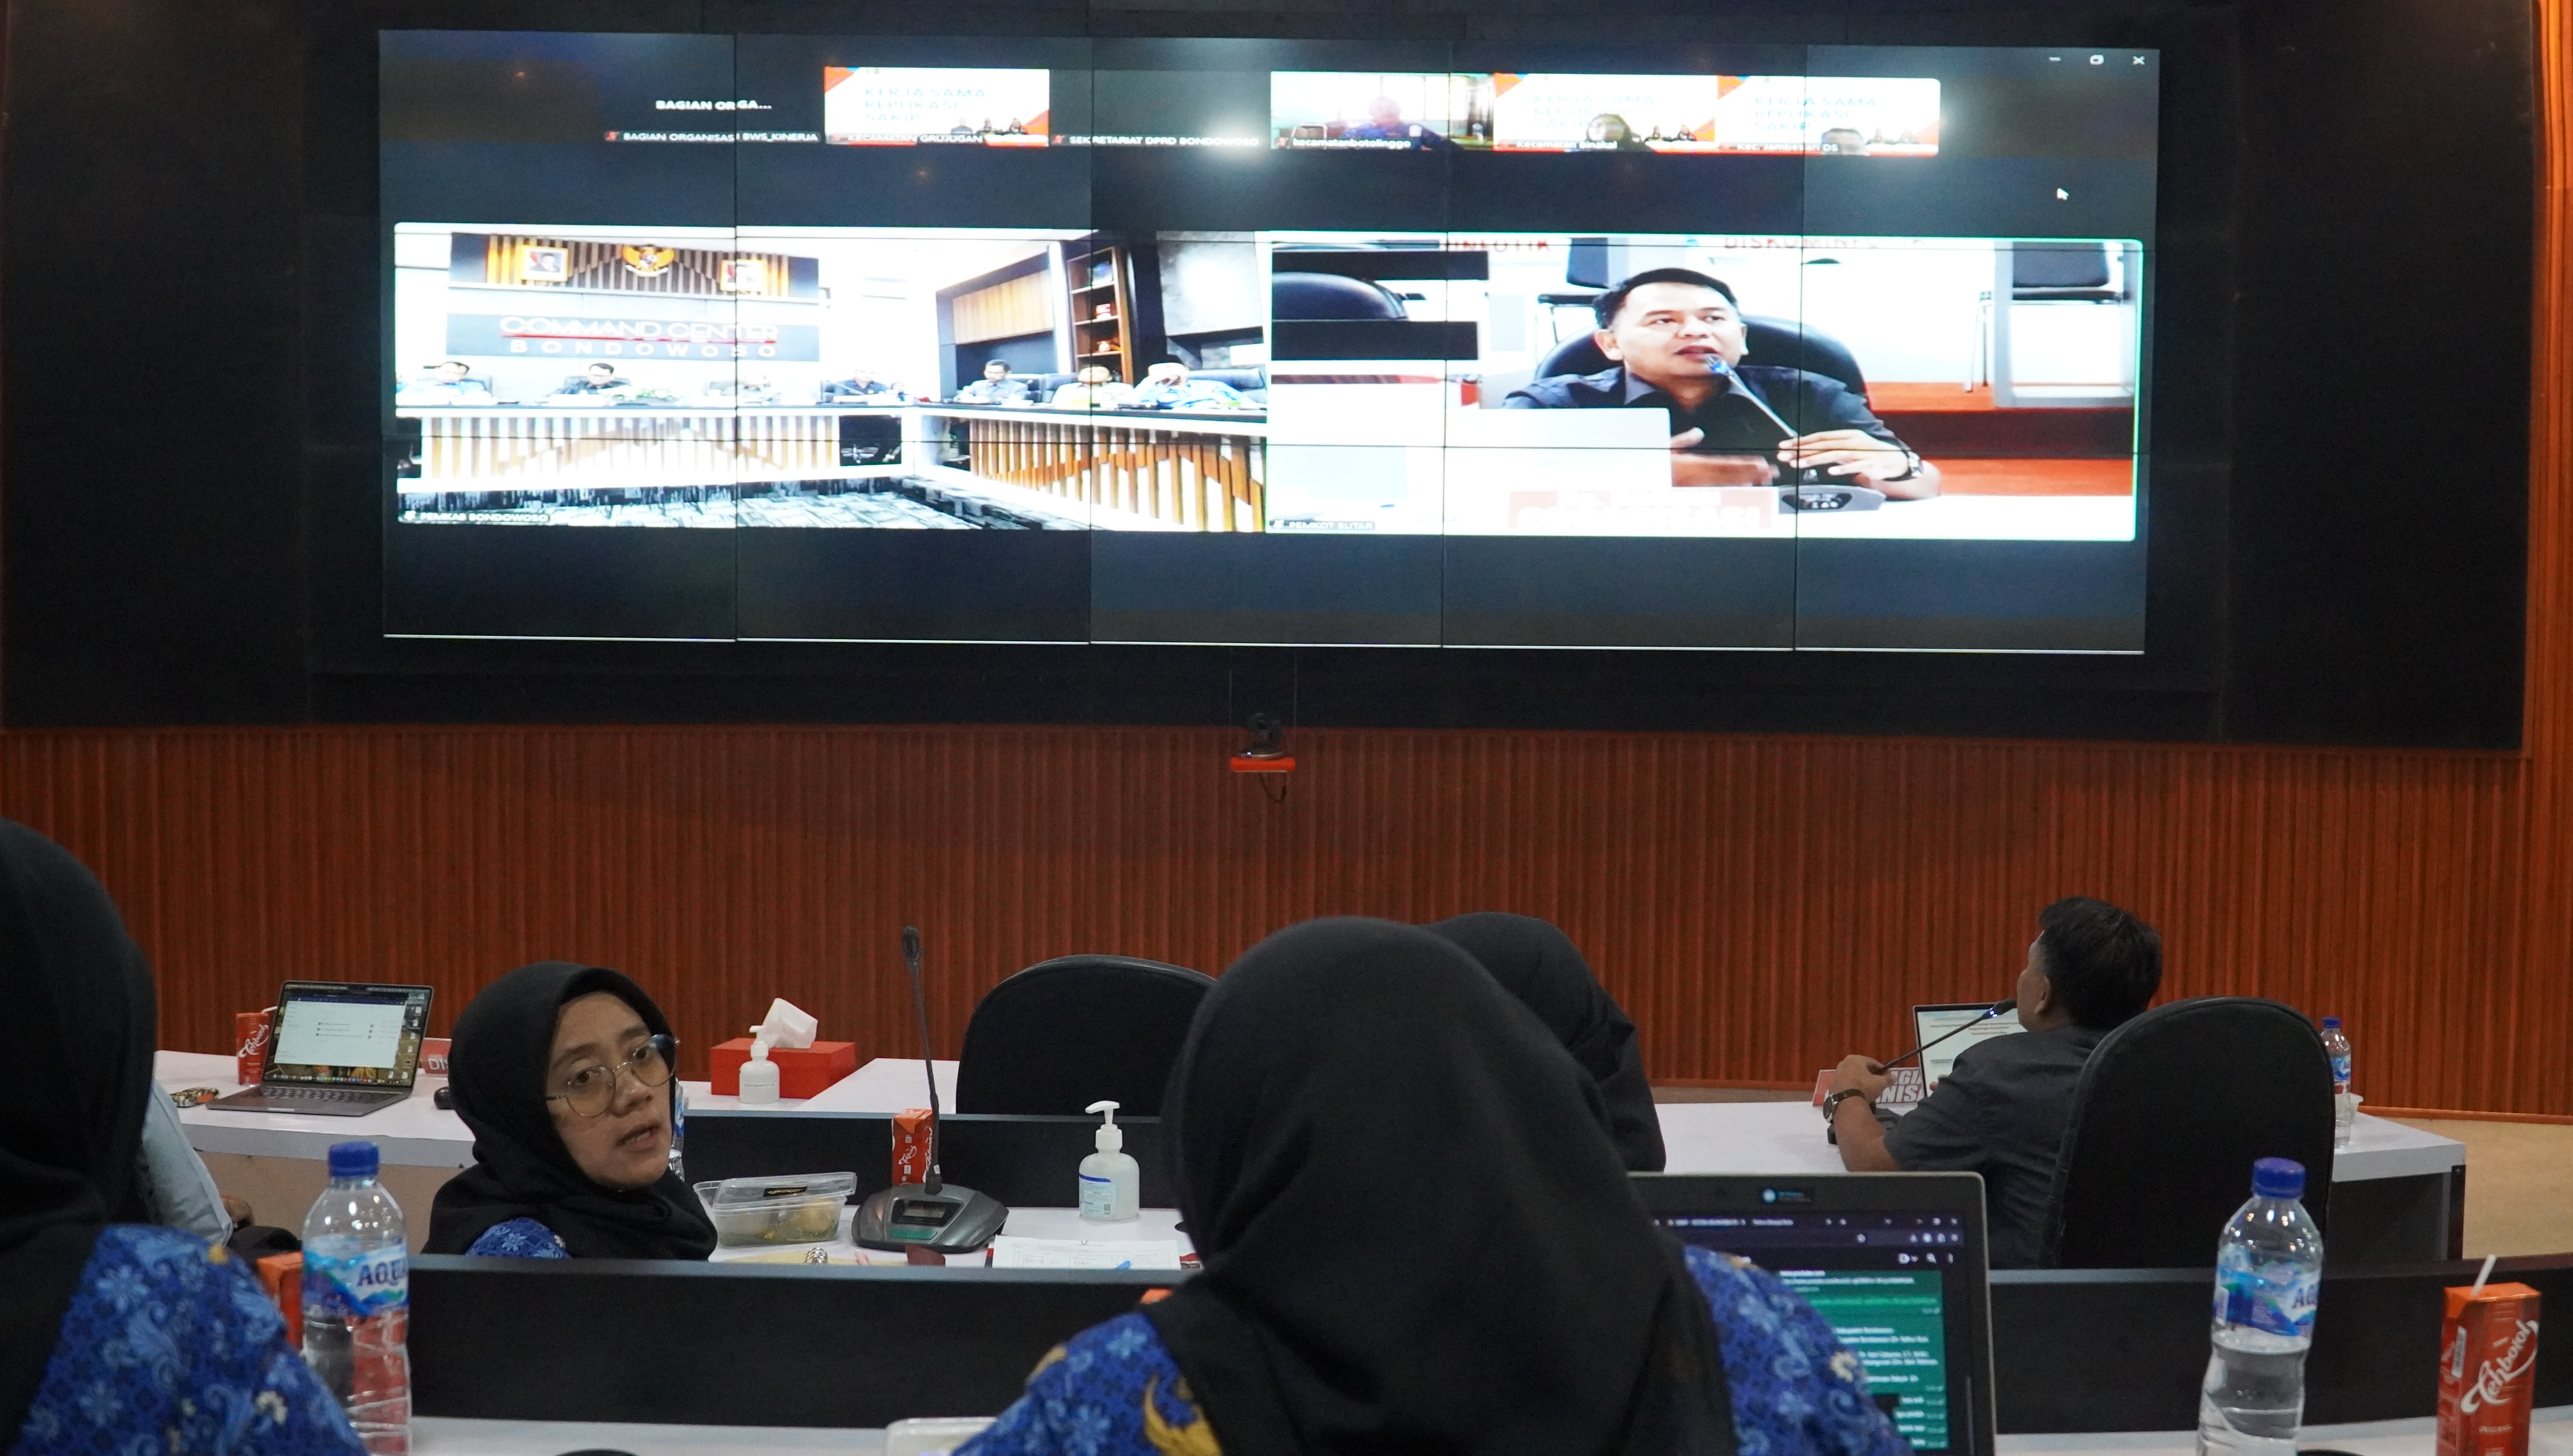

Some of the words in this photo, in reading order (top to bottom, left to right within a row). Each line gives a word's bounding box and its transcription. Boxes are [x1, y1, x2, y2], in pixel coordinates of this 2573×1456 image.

[865, 88, 924, 97] KERJA
[931, 88, 986, 97] SAMA
[655, 100, 712, 110] BAGIAN
[623, 132, 667, 141] BAGIAN
[669, 132, 740, 142] ORGANISASI
[848, 133, 917, 142] KECAMATAN
[919, 134, 983, 143] GRUJUGAN
[1070, 136, 1143, 145] SEKRETARIAT
[1145, 136, 1177, 145] DPRD
[1179, 136, 1259, 146] BONDOWOSO
[1516, 140, 1577, 149] Kecamatan
[1579, 140, 1617, 149] Binakal
[499, 316, 662, 339] COMMAND
[668, 322, 779, 342] CENTER
[510, 339, 777, 357] BONDOWOSO
[421, 512, 467, 521] PEMKAB
[469, 513, 548, 522] BONDOWOSO
[357, 1257, 408, 1287] AQU
